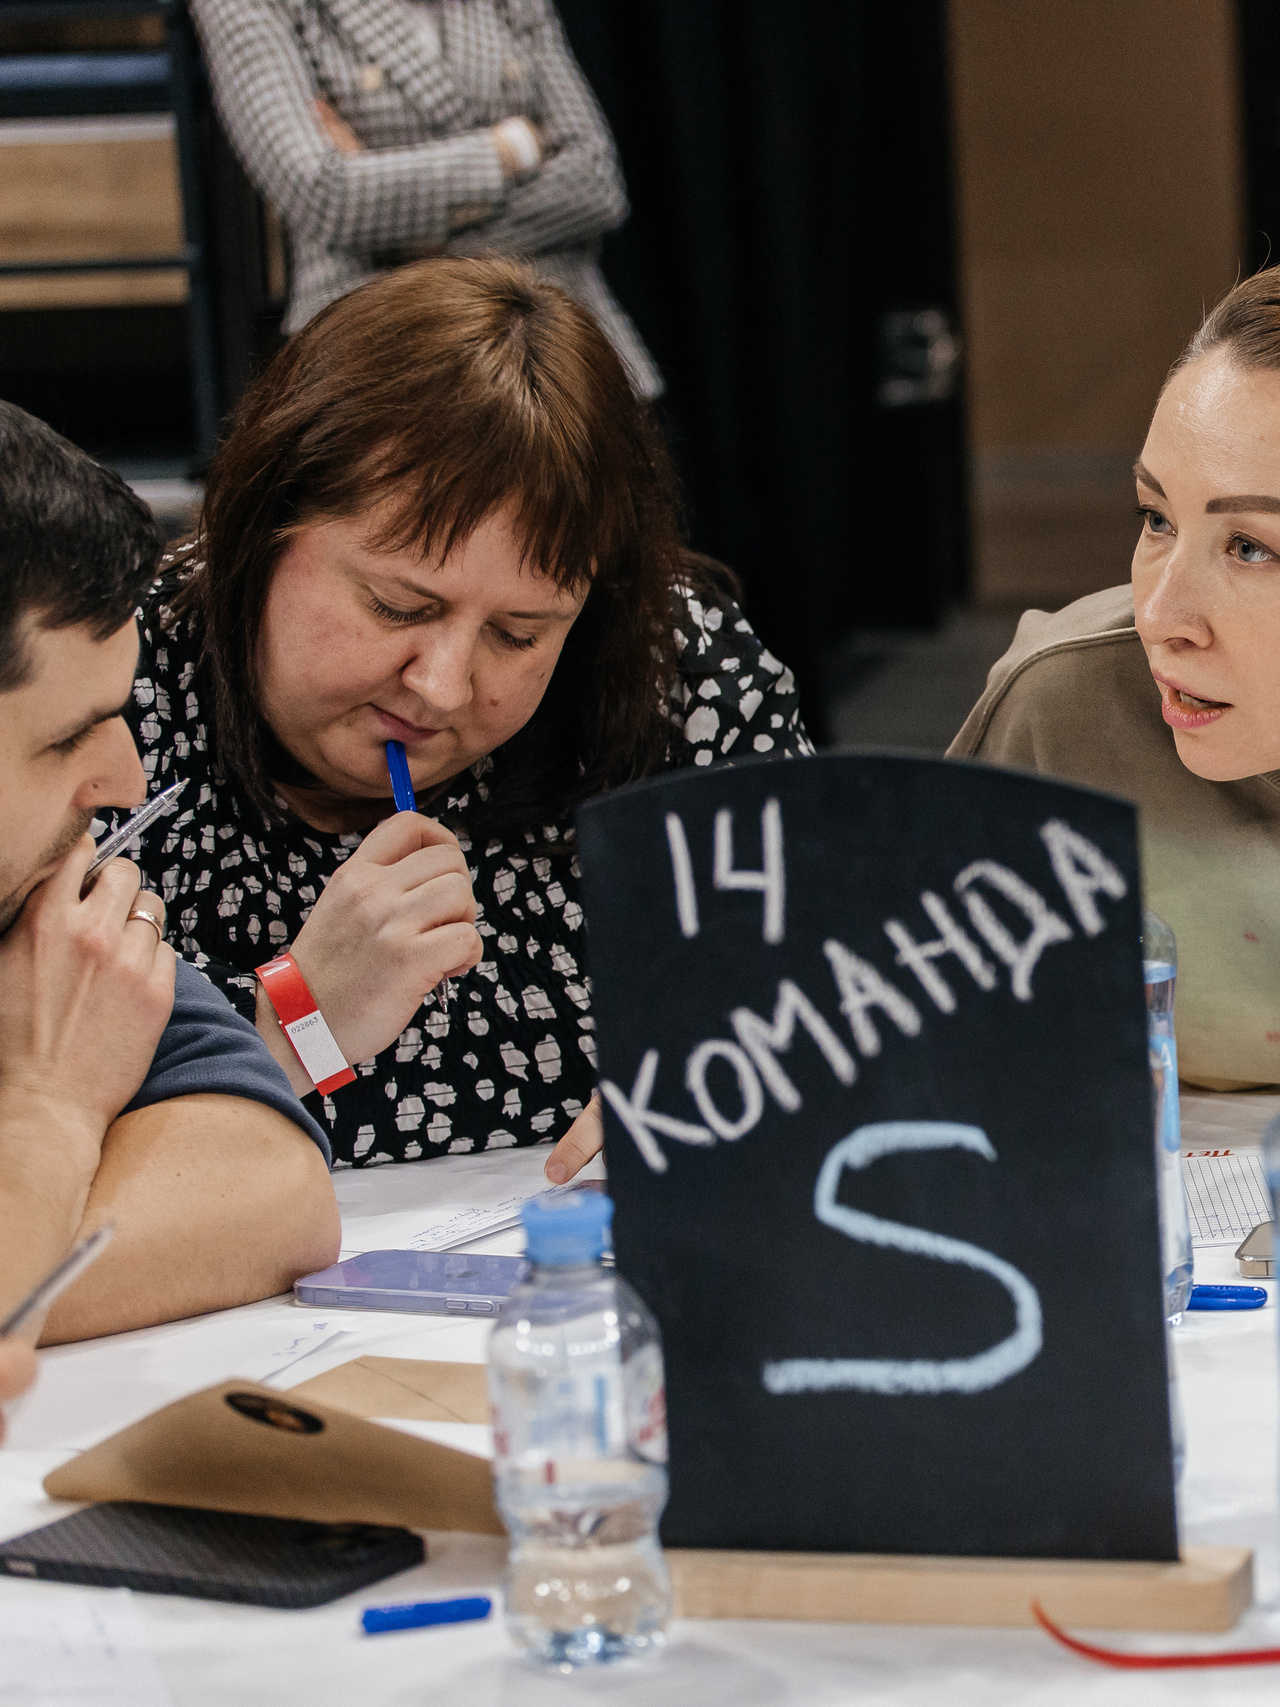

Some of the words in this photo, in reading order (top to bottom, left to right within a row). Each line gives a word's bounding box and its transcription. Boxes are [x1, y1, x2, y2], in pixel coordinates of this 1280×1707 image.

[599, 818, 1128, 1173] КОМАНДА
[666, 797, 787, 945] 14
[762, 1120, 1044, 1395] S
